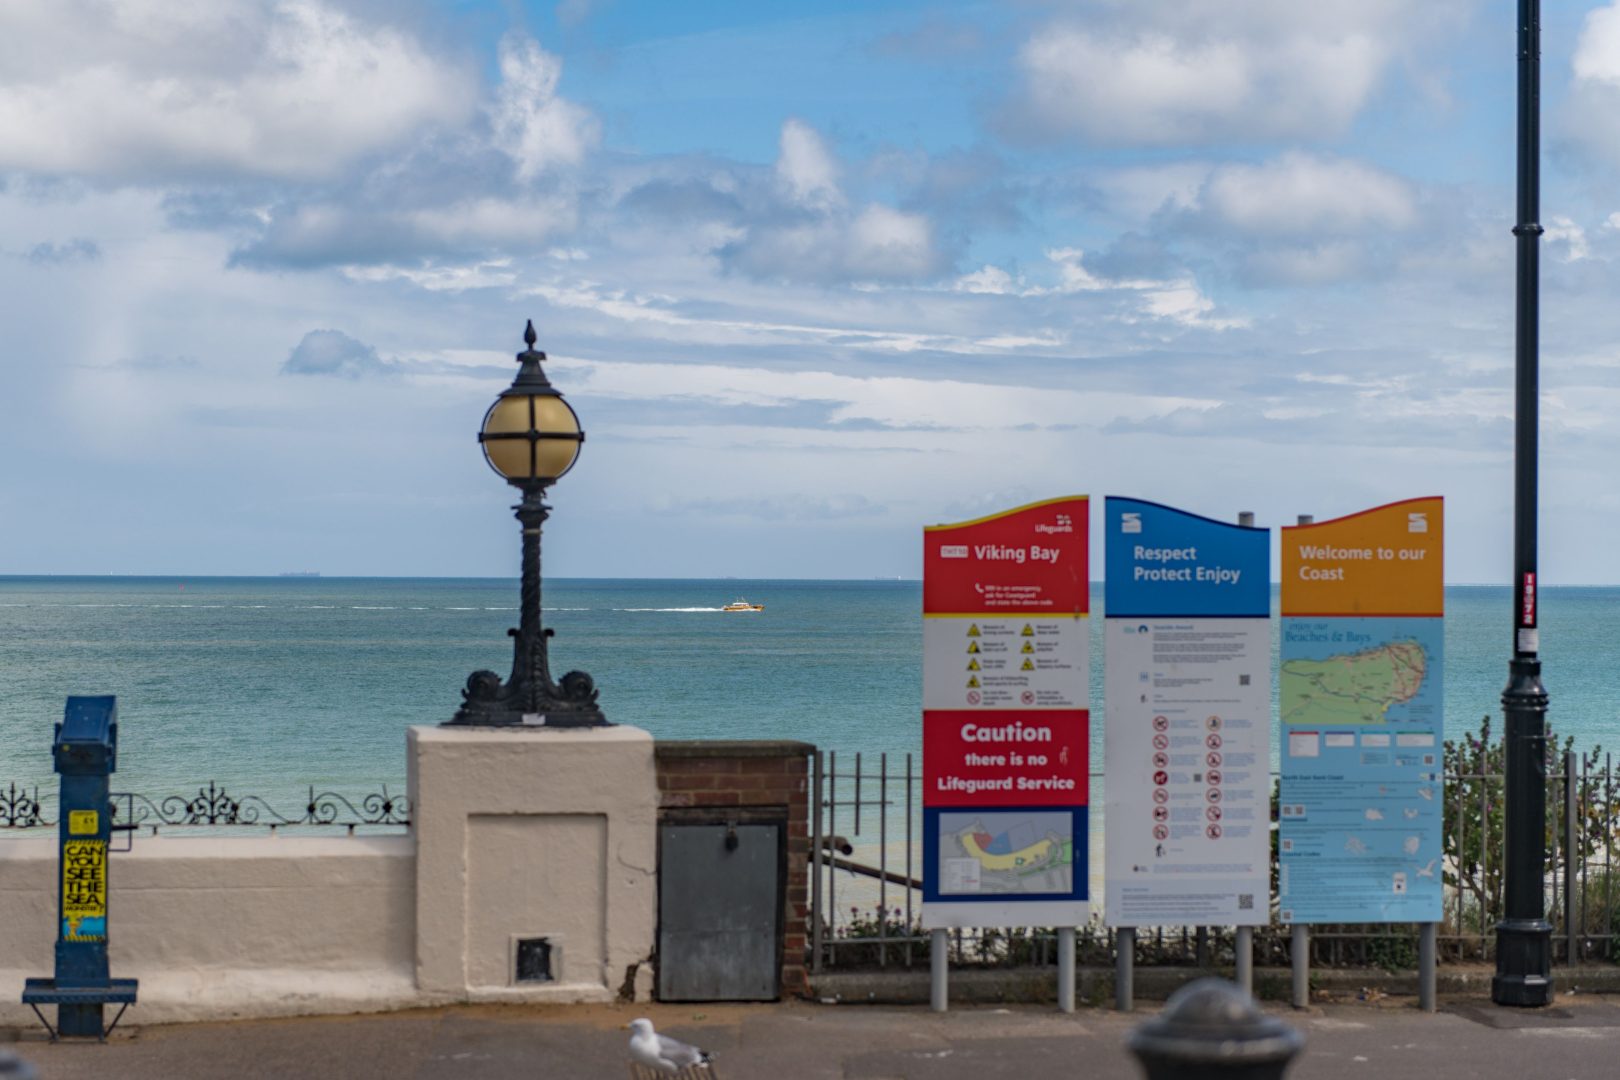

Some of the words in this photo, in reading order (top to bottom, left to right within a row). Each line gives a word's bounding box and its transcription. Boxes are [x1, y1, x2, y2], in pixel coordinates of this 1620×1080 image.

[1035, 524, 1072, 534] Lifeguards
[975, 545, 1025, 563] Viking
[1030, 546, 1060, 563] Bay
[1134, 546, 1197, 563] Respect
[1299, 545, 1372, 560] Welcome
[1377, 547, 1394, 560] to
[1398, 548, 1426, 560] our
[1134, 566, 1192, 581] Protect
[1196, 566, 1240, 584] Enjoy
[1299, 566, 1344, 580] Coast
[1285, 631, 1328, 642] Beaches
[1331, 632, 1343, 642] &
[1346, 632, 1372, 644] Bays
[961, 722, 1052, 742] Caution
[965, 753, 1005, 766] there
[1010, 752, 1023, 766] is
[1028, 756, 1048, 766] no
[938, 776, 1012, 794] Lifeguard
[1017, 776, 1075, 790] Service
[66, 846, 102, 856] CAN
[68, 856, 102, 867] YOU
[66, 868, 102, 880] SEE
[66, 881, 102, 893] THE
[66, 893, 100, 905] SEA
